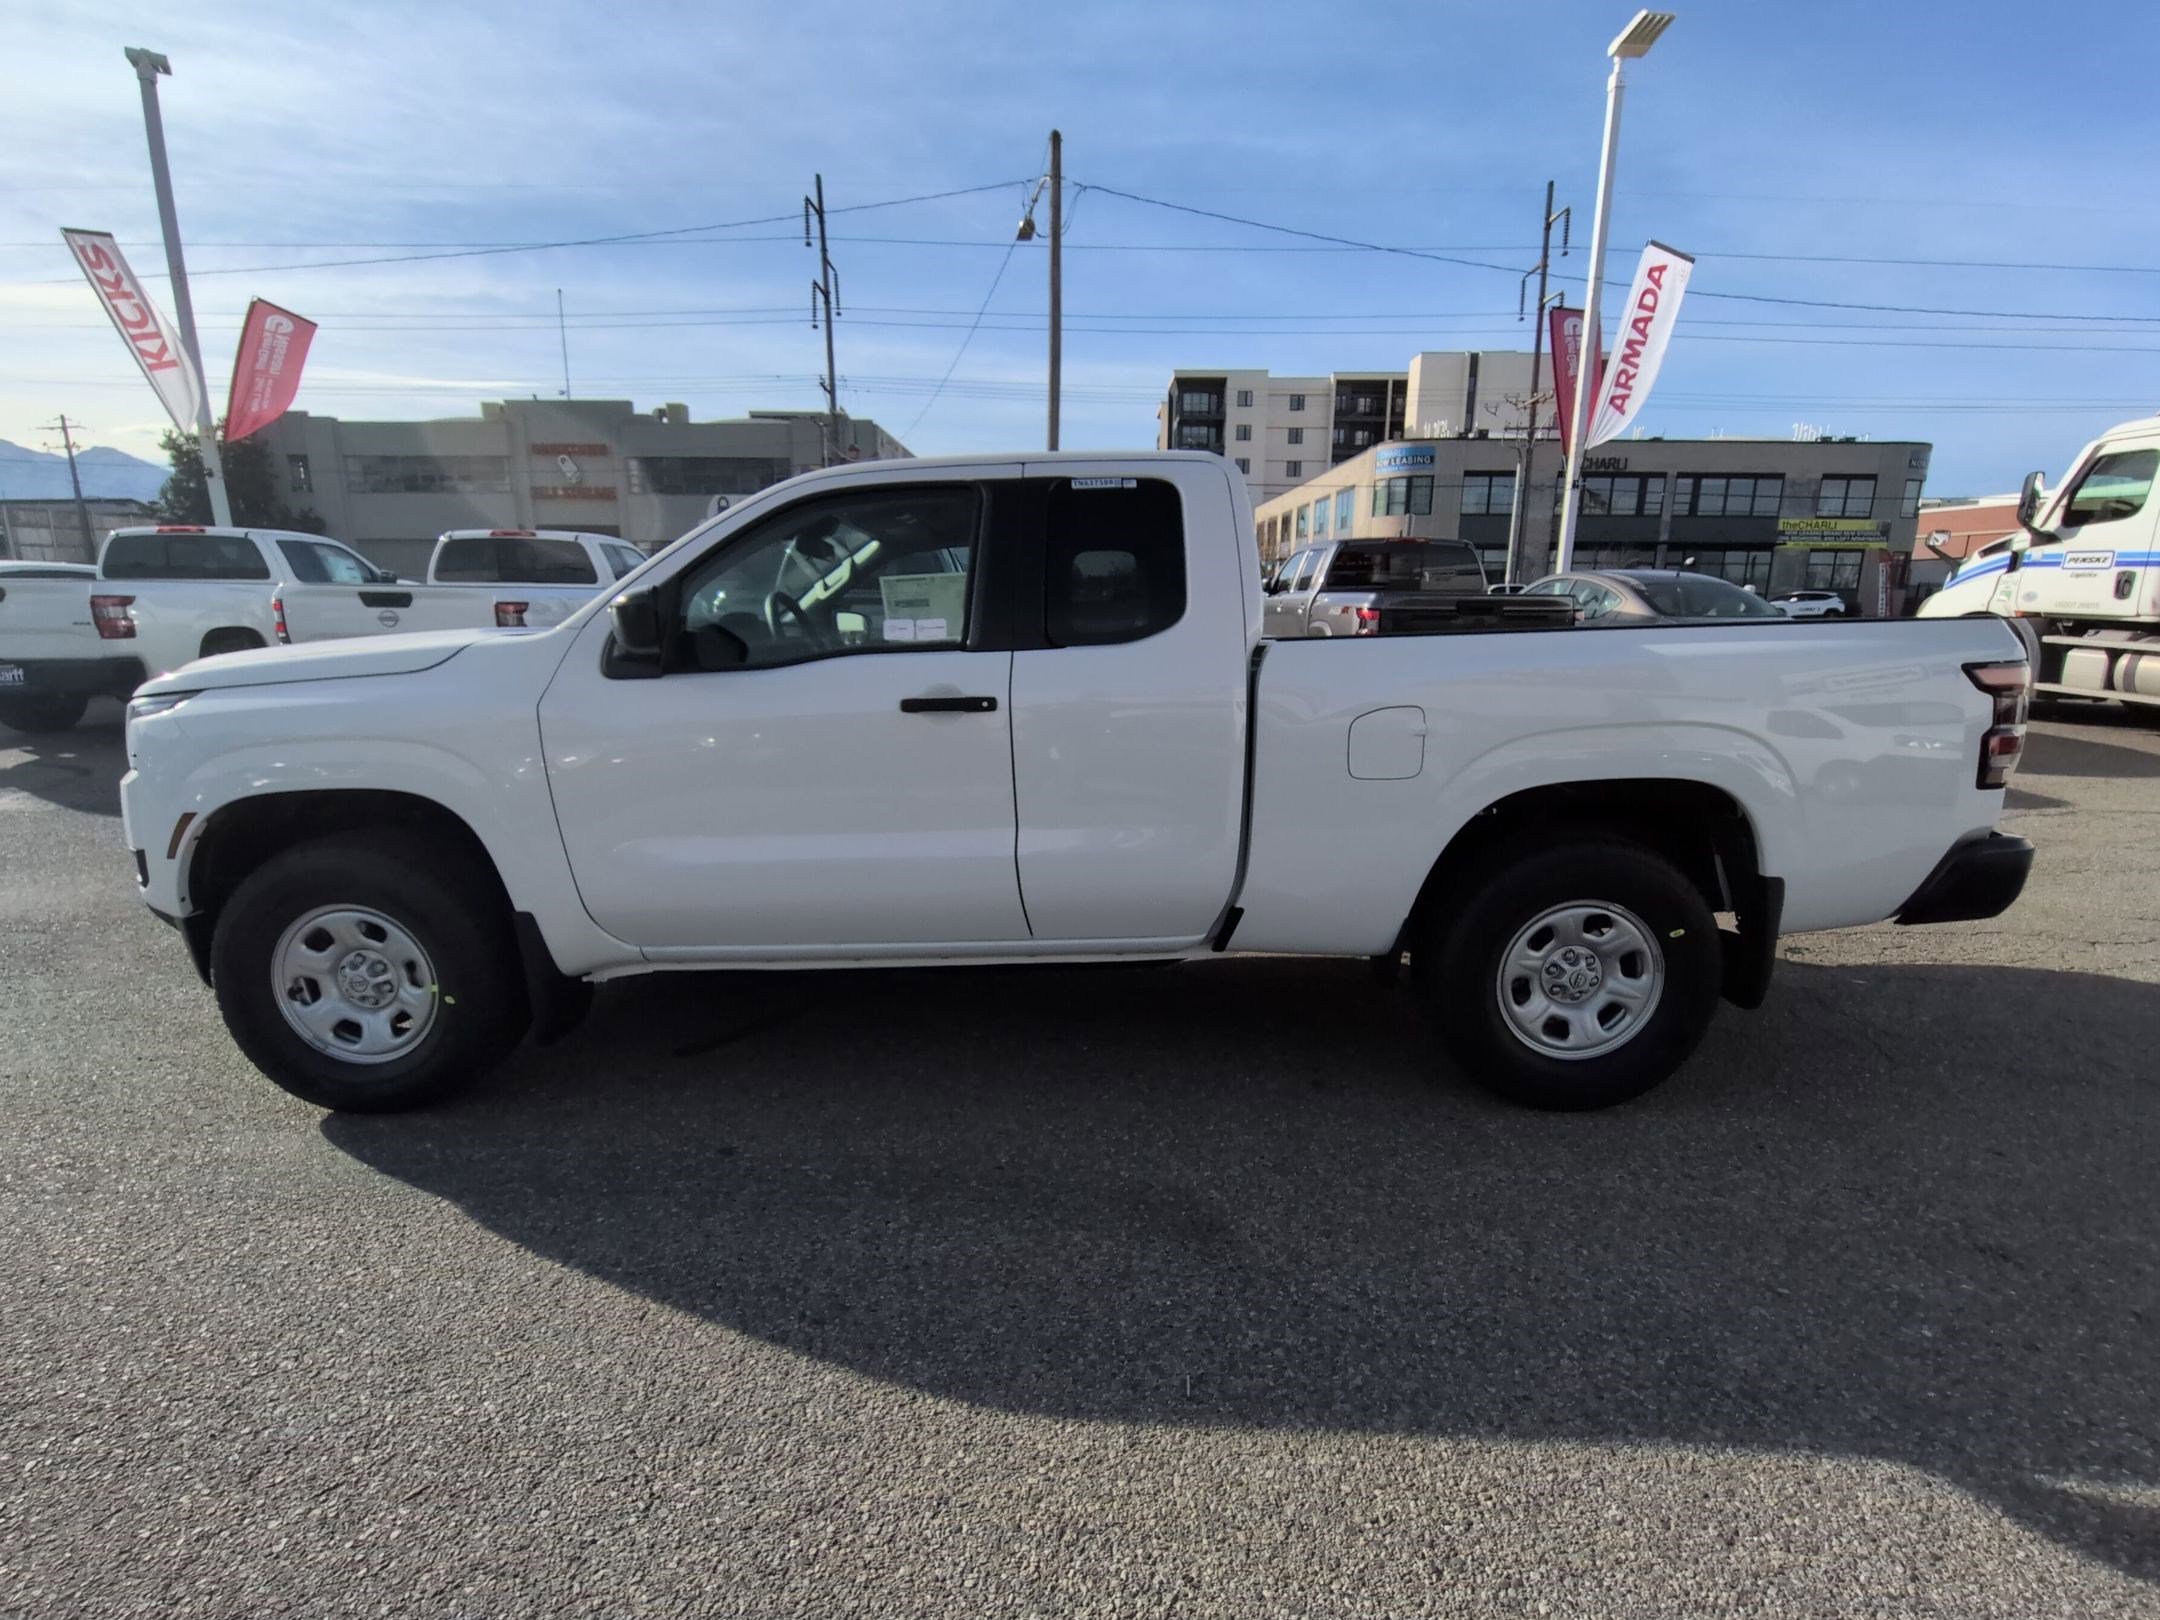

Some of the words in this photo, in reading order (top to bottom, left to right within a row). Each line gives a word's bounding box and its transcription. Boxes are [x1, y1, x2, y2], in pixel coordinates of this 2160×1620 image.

[79, 243, 179, 372] KICKS
[1609, 264, 1668, 416] ARMADA
[1391, 455, 1432, 465] LEASING
[1782, 520, 1838, 529] theCHARLI
[2067, 556, 2110, 564] PENSKE
